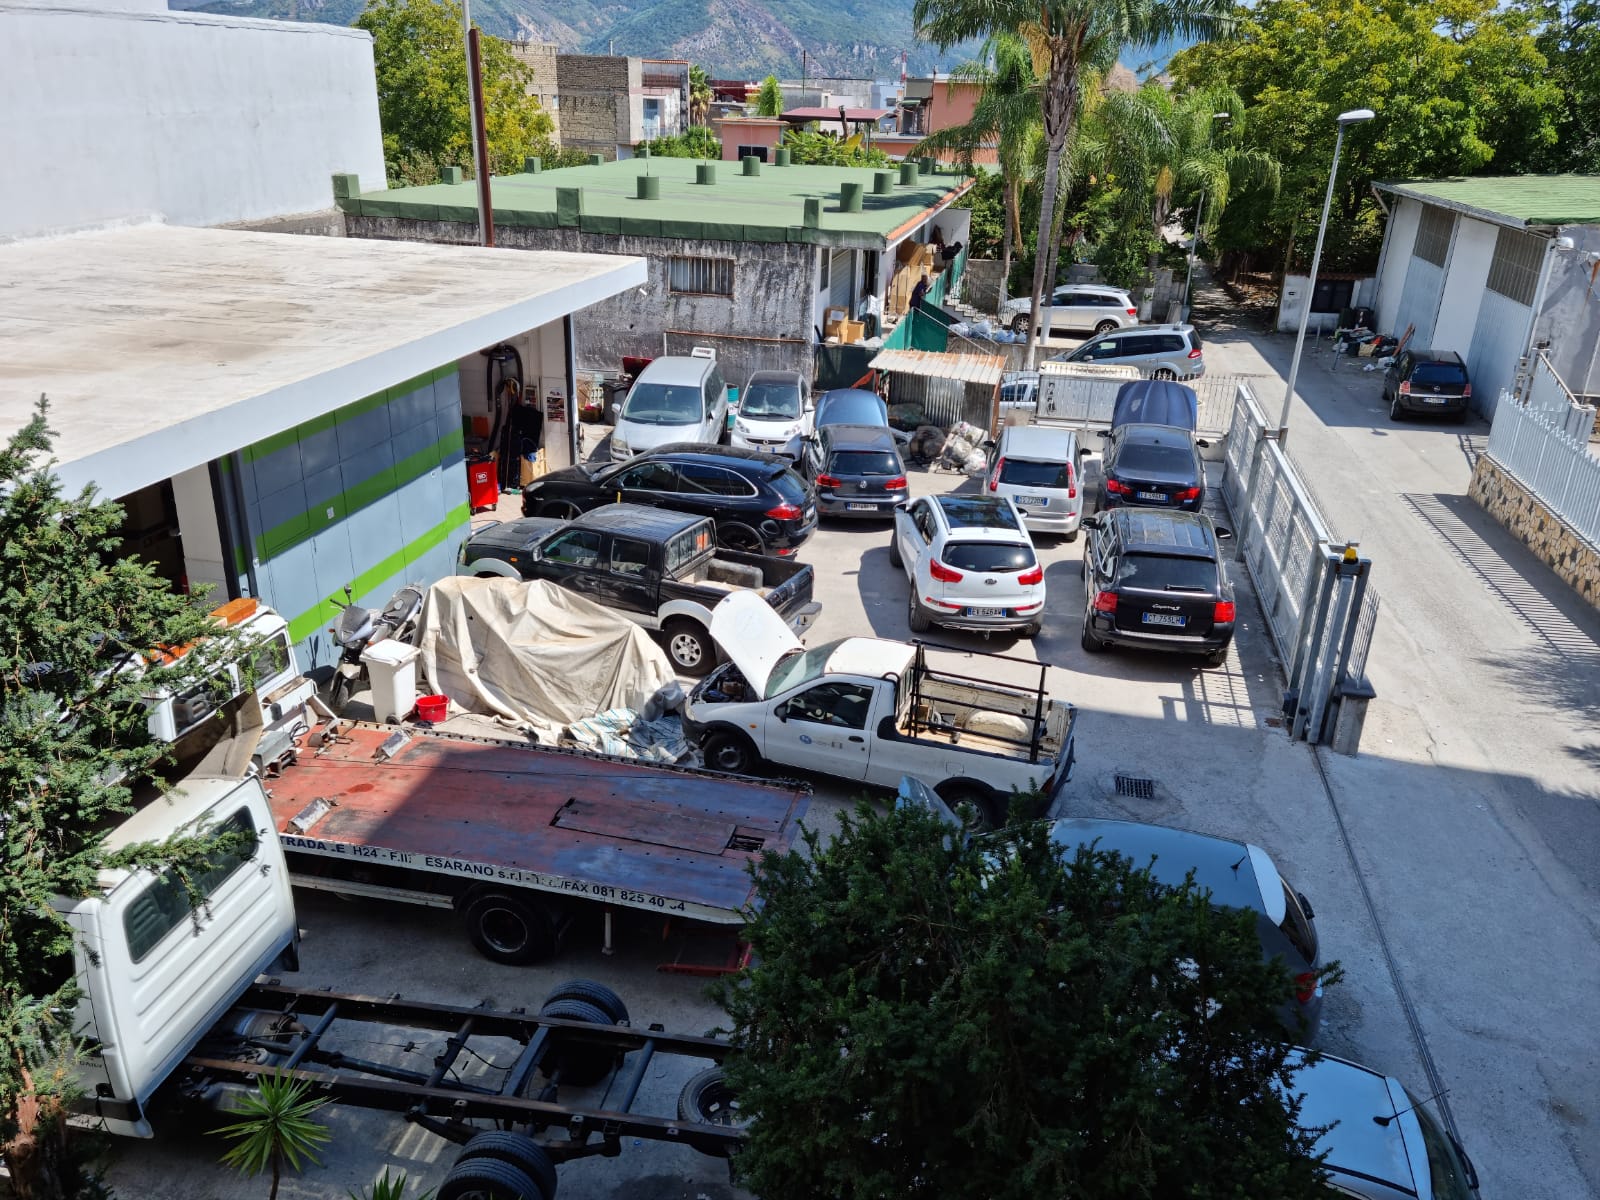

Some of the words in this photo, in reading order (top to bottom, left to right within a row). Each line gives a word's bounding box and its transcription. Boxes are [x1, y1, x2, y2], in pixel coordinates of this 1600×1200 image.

[353, 846, 378, 858] H24
[592, 885, 615, 898] 081
[621, 890, 645, 903] 825
[648, 897, 665, 908] 40
